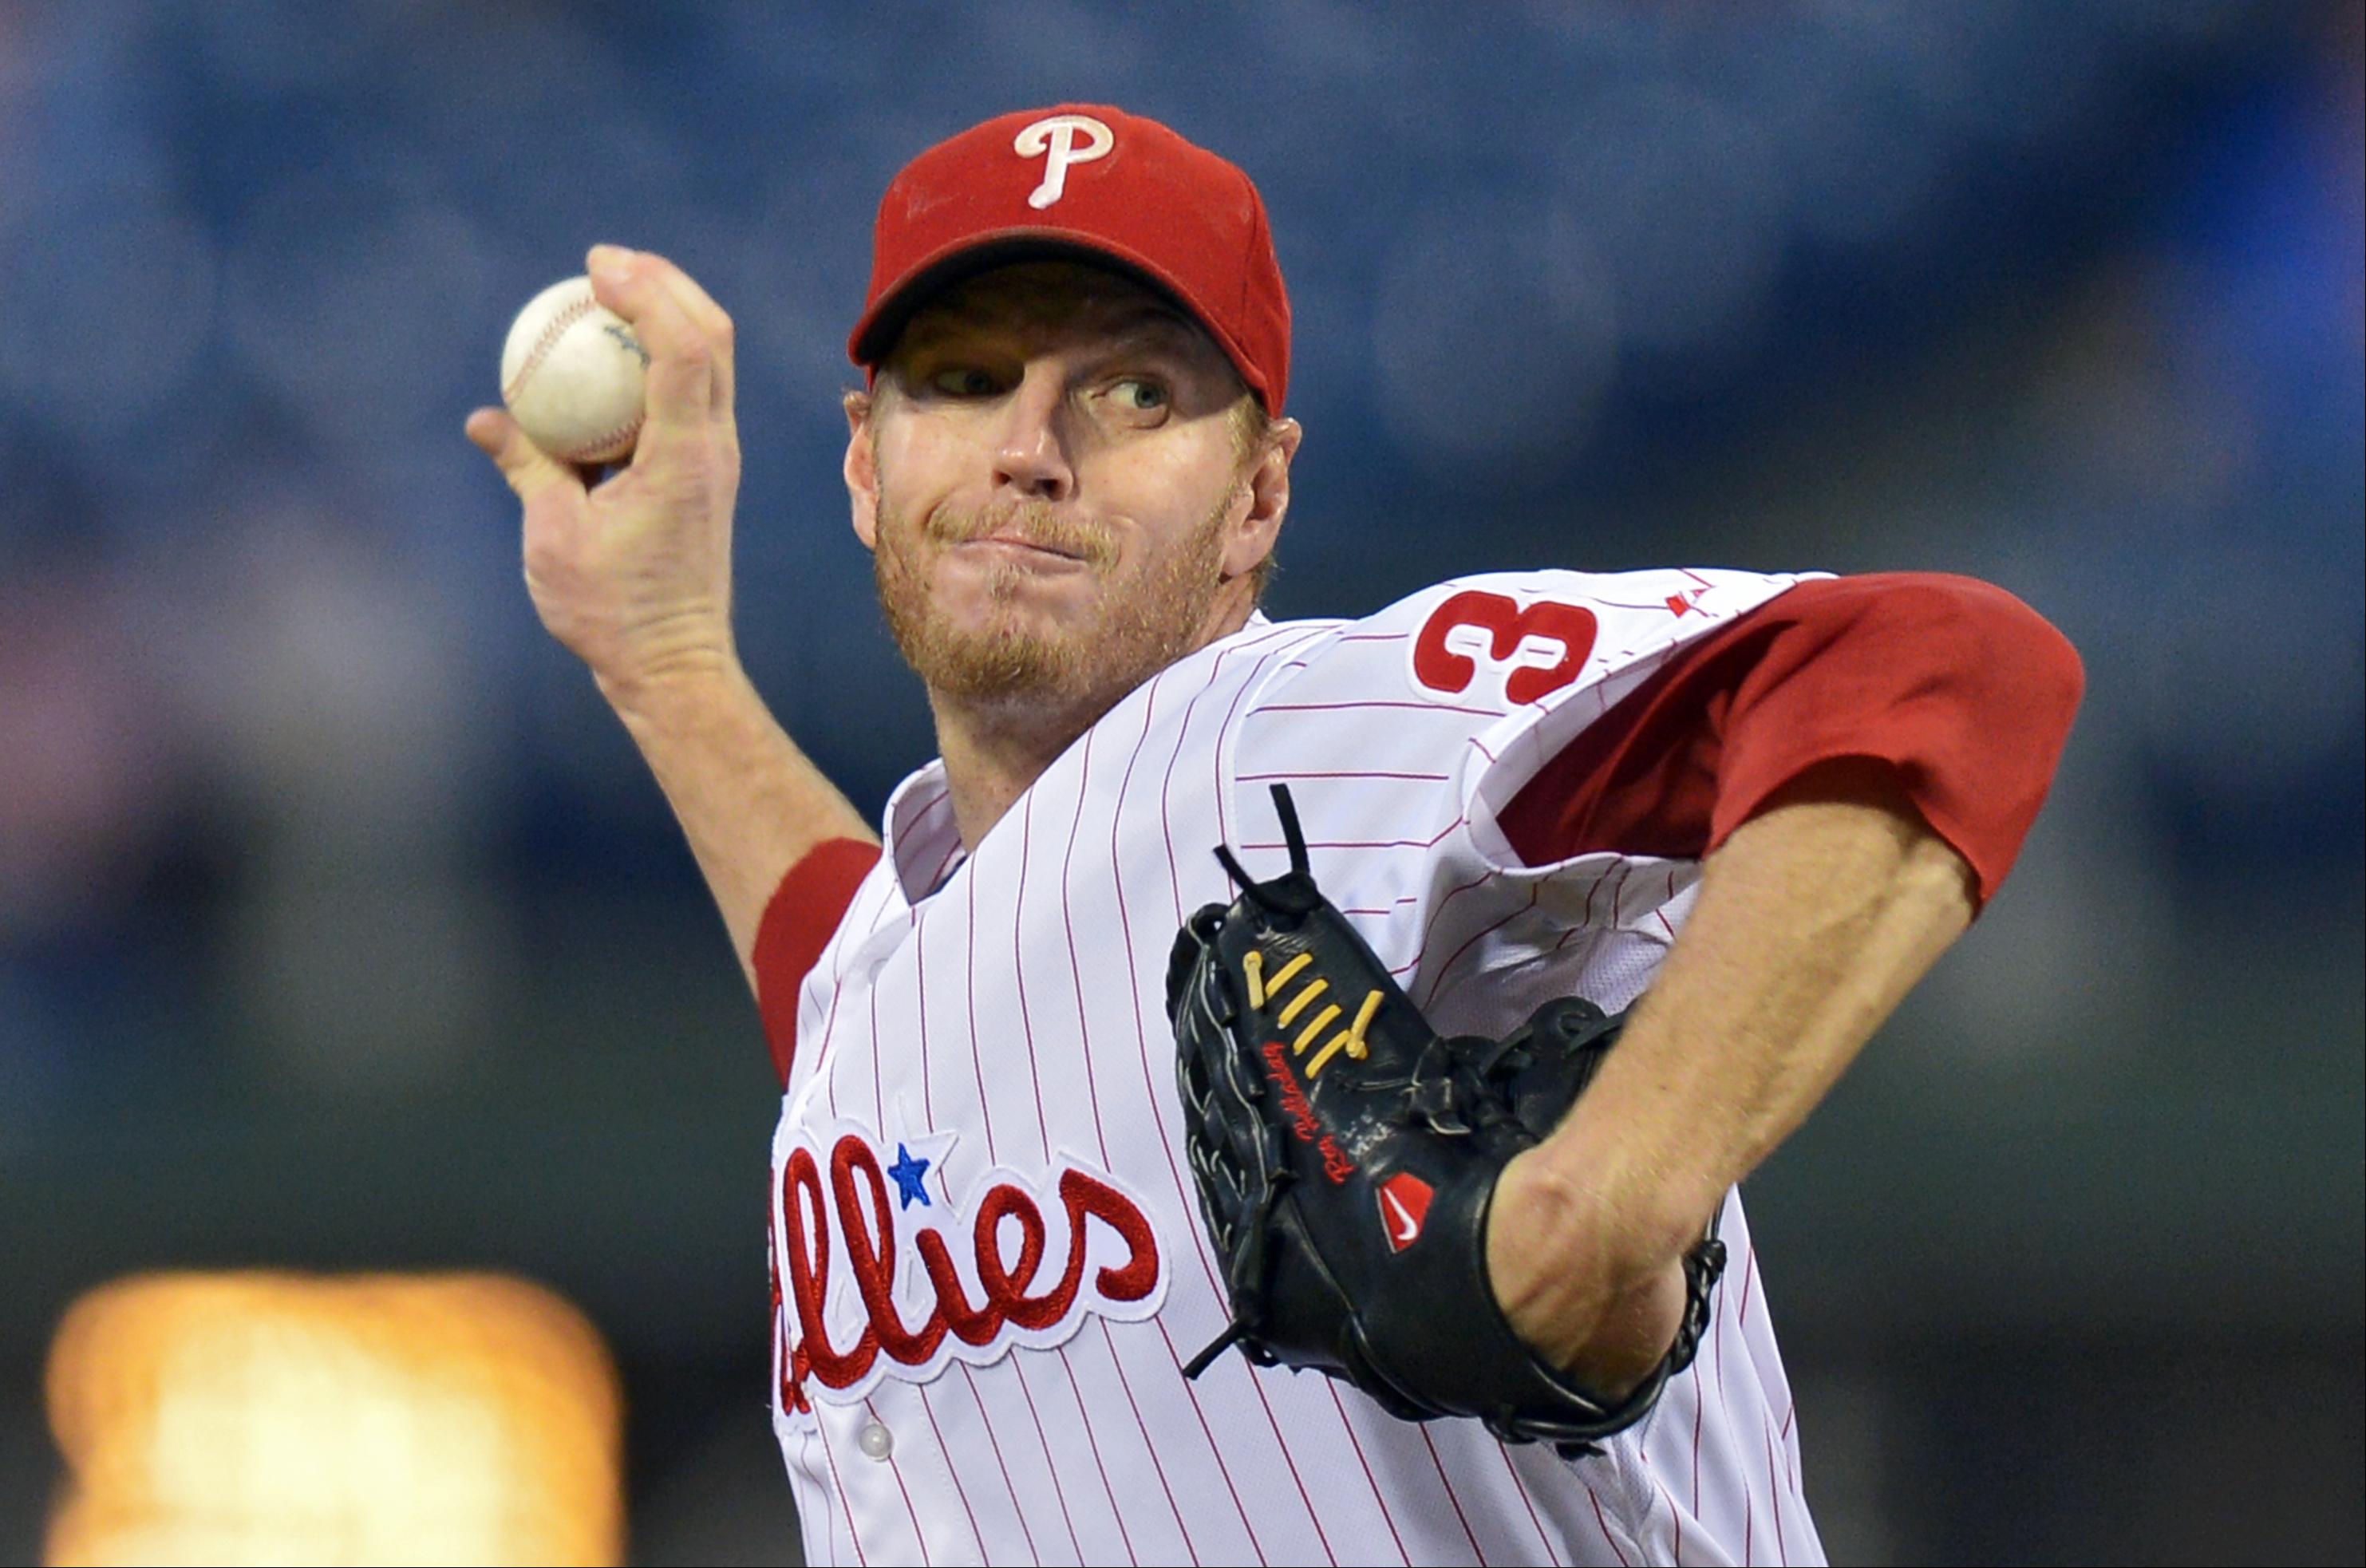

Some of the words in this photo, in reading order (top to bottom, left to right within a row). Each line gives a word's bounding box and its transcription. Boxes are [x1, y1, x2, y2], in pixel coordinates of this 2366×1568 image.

[1013, 114, 1114, 209] P
[1413, 590, 1598, 705] 3
[1318, 1133, 1356, 1185] Roy
